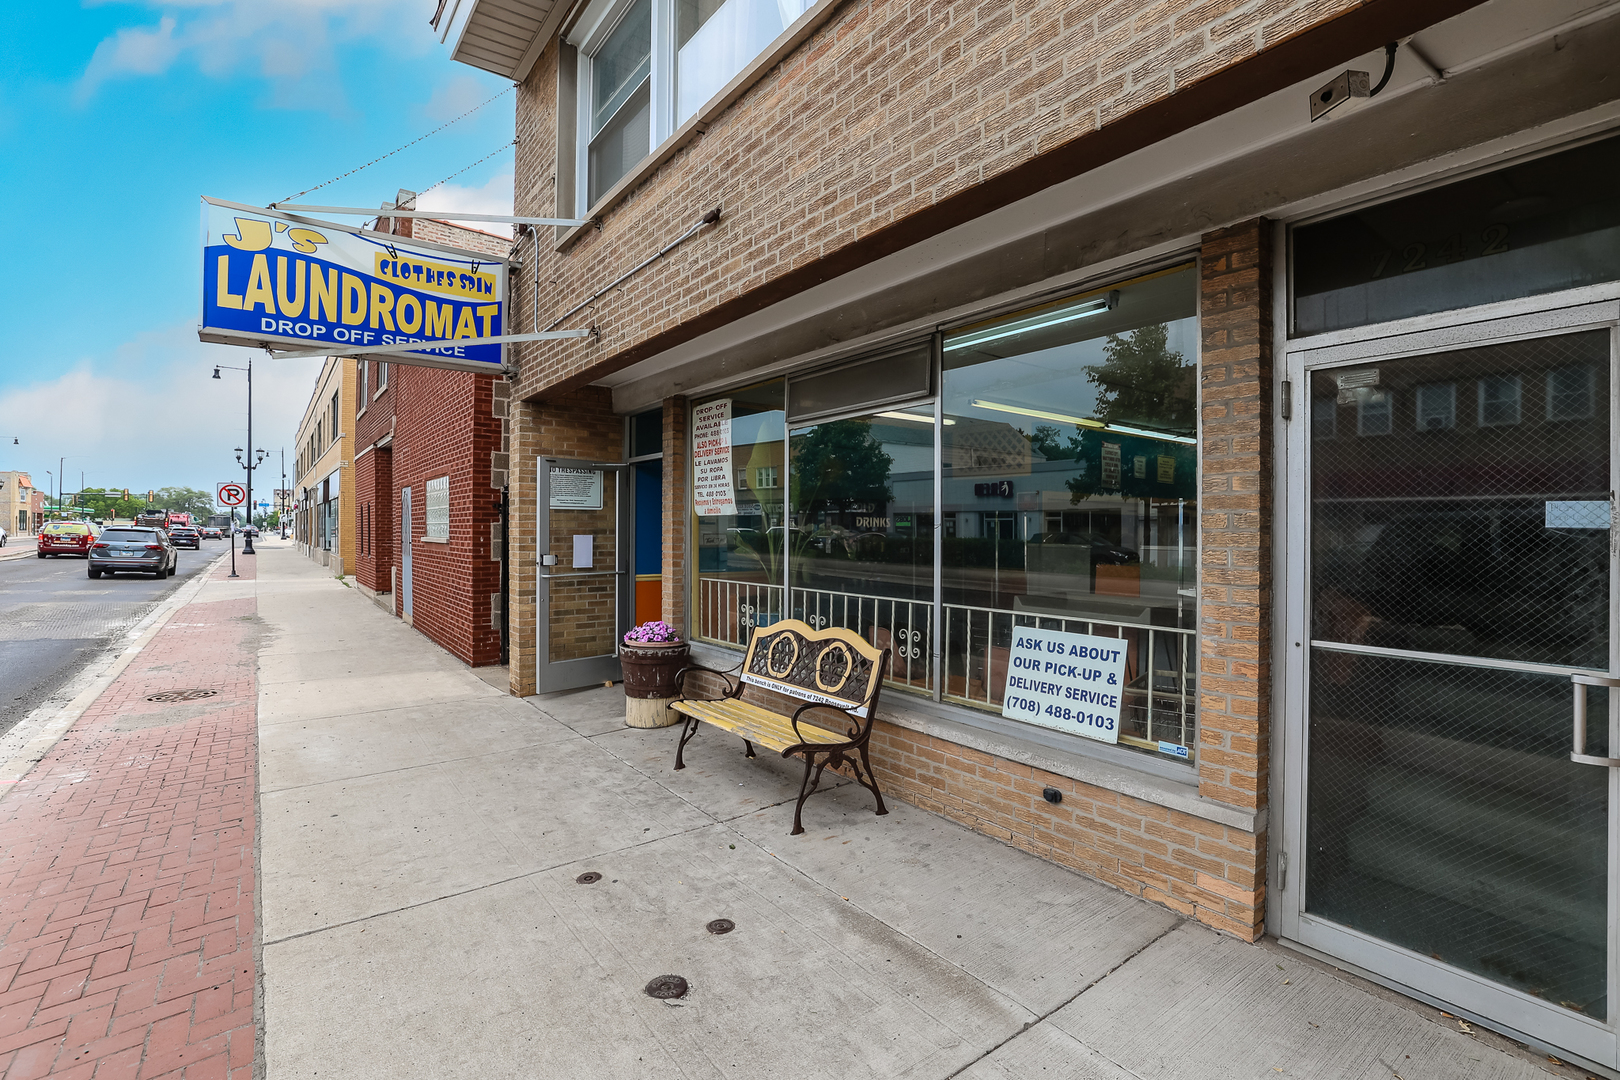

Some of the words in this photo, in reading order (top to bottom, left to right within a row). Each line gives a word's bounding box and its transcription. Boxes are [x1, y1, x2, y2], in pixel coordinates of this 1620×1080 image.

[222, 216, 329, 254] J's
[1369, 222, 1510, 280] 7242
[216, 253, 499, 345] LAUNDROMAT
[261, 317, 327, 337] DROP
[333, 328, 376, 345] OFF
[699, 412, 724, 422] SERVICE
[695, 449, 714, 458] DELIVERY
[714, 446, 730, 457] SERVICE
[704, 457, 728, 466] LAVAMOS
[855, 516, 891, 528] DRINKS
[1015, 636, 1043, 652] ASK
[1046, 641, 1065, 655] US
[1068, 644, 1121, 663] ABOUT
[1013, 656, 1041, 672] OUR
[1044, 661, 1102, 682] PICK-UP
[1106, 672, 1118, 686] &
[754, 678, 766, 686] bench
[771, 682, 782, 690] ONLY
[789, 688, 806, 698] patrons
[813, 695, 824, 704] 7242
[1009, 675, 1063, 697] DELIVERY
[1064, 685, 1118, 709] SERVICE
[1006, 695, 1041, 716] (708)
[1044, 704, 1115, 731] 488-0103
